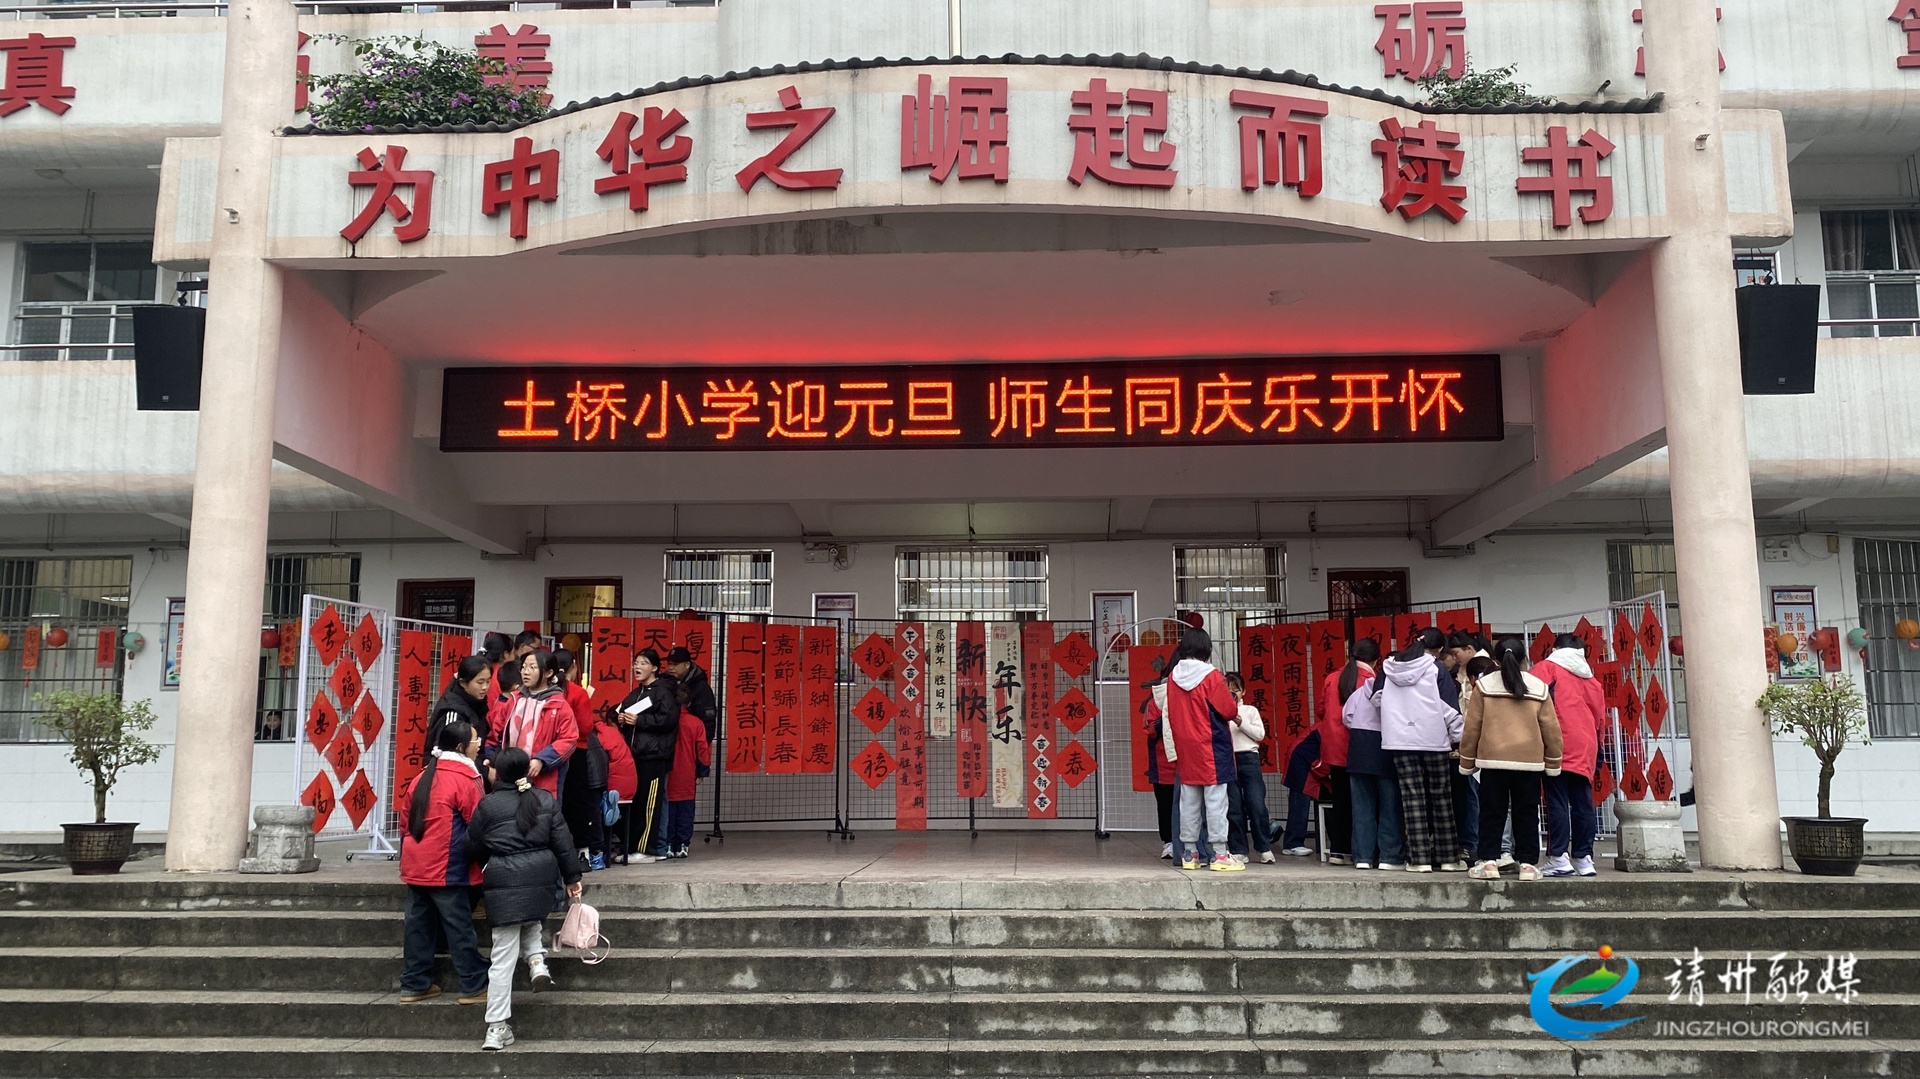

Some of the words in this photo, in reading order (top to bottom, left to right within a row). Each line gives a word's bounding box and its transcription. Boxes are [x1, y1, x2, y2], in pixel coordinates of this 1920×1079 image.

[0, 33, 76, 115] 真
[340, 74, 1616, 243] 为中华之崛起而读书
[497, 378, 961, 441] 土桥小学迎元旦
[989, 368, 1465, 437] 师生同庆乐开怀
[1065, 751, 1085, 775] 春
